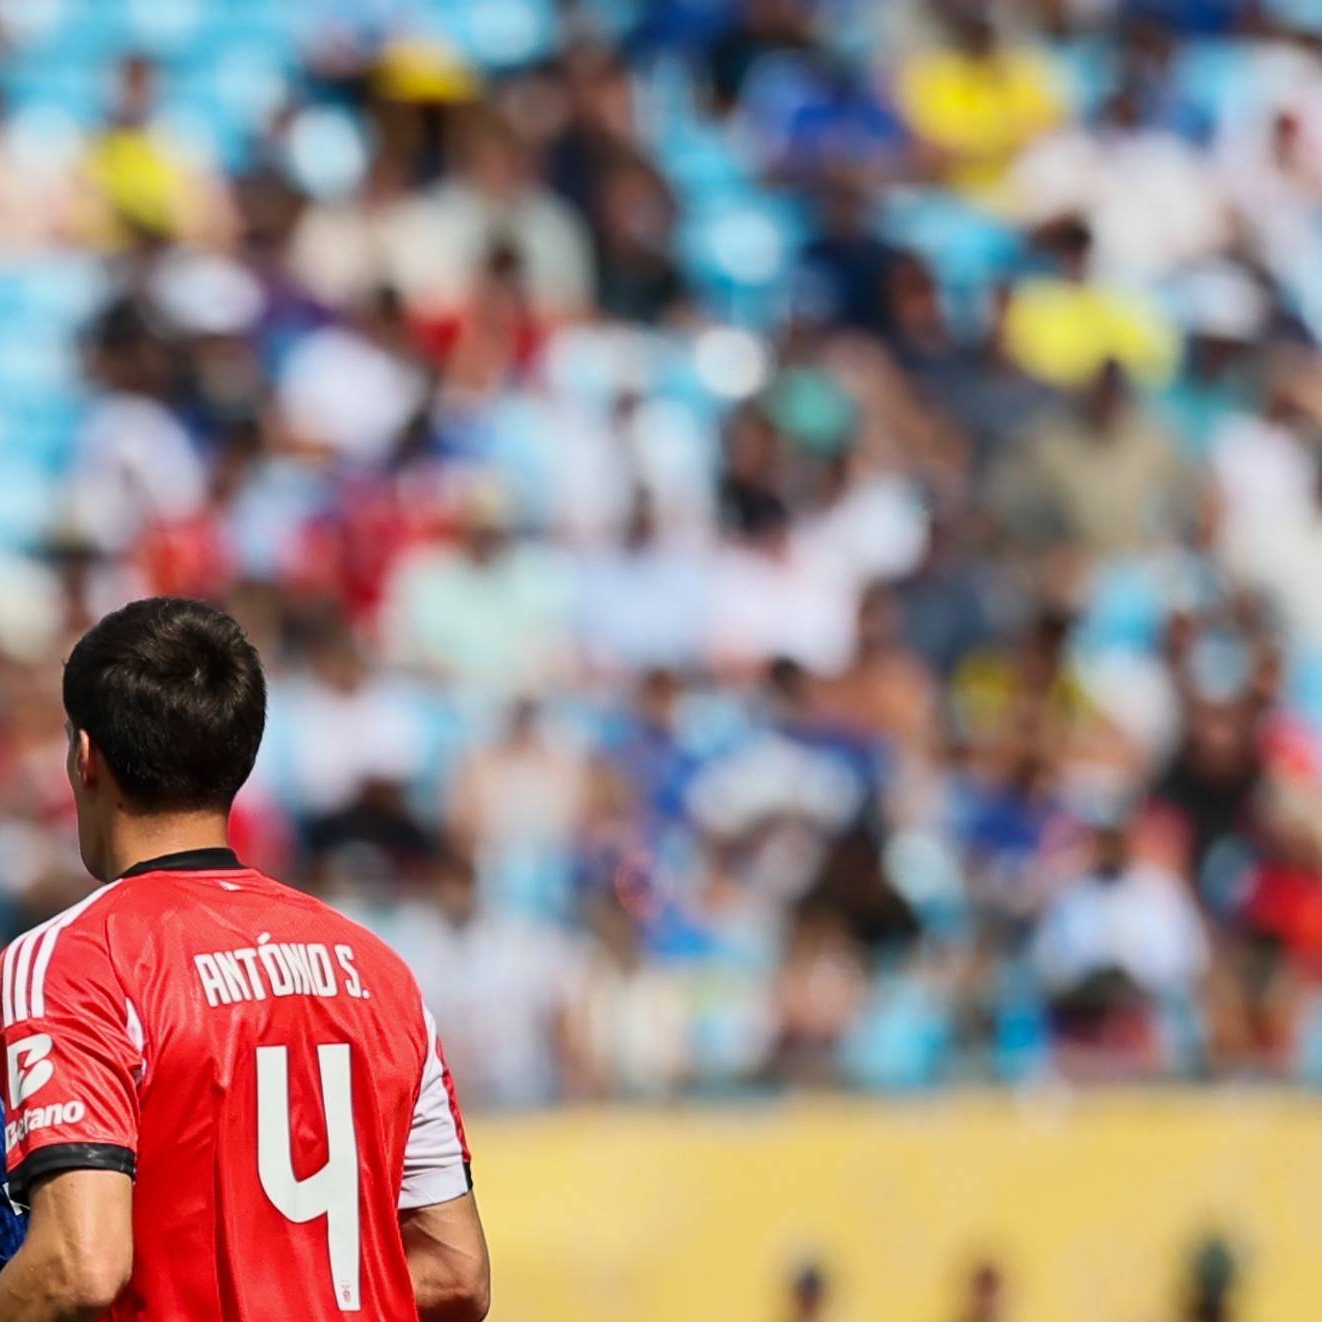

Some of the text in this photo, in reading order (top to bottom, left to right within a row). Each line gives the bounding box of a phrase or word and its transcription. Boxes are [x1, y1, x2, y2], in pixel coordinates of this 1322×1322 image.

[193, 931, 371, 1007] ANTÓNIO S.
[256, 1043, 361, 1312] 4
